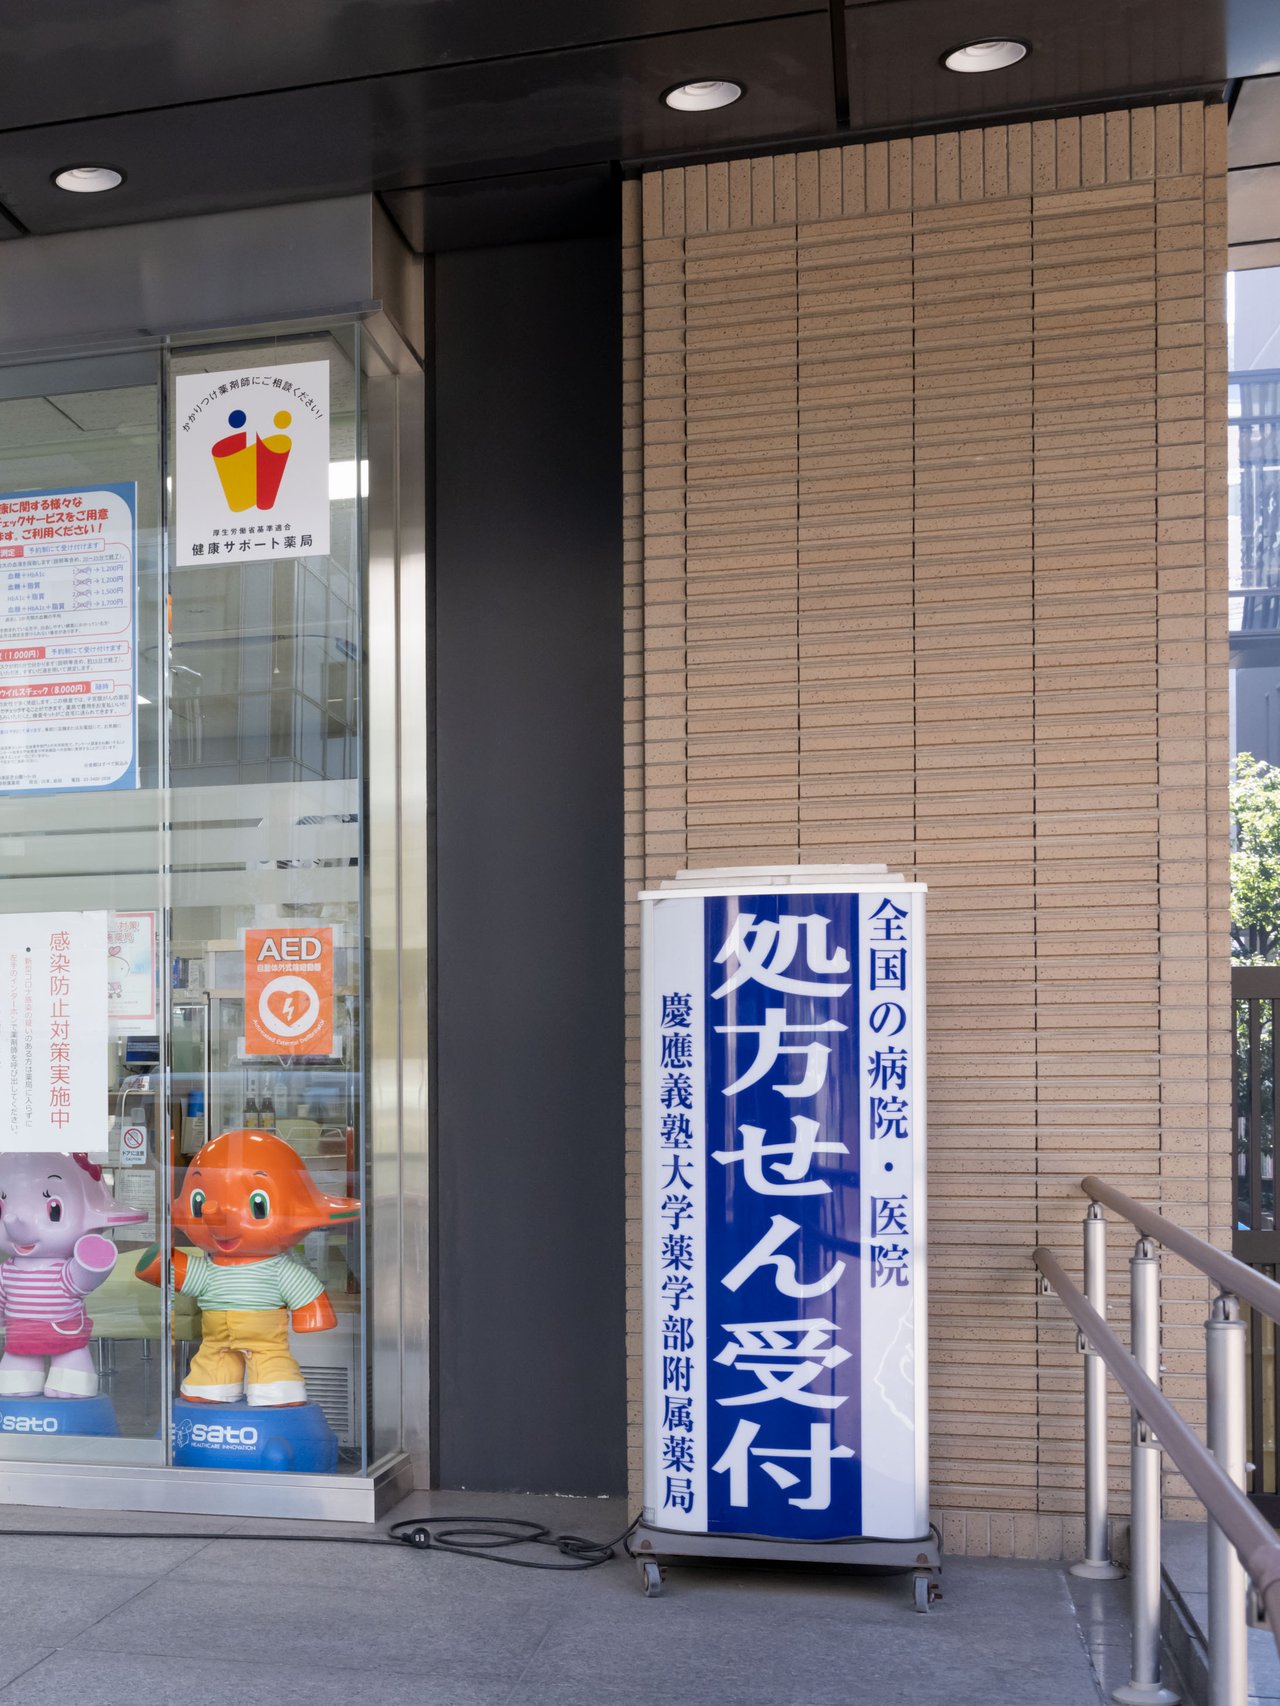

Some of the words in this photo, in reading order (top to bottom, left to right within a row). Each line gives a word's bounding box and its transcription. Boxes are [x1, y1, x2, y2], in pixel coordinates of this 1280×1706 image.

[212, 523, 292, 537] 厚生労働省基準適合
[191, 534, 313, 556] 健康サポート薬局
[256, 936, 322, 962] AED
[49, 930, 71, 1129] 感染防止対策実施中
[867, 897, 910, 1290] 全国の病院・医院
[710, 911, 856, 1511] 処方せん受付
[660, 991, 695, 1515] 慶應義塾大学薬学部附属薬局
[2, 1415, 58, 1433] sato
[191, 1423, 258, 1445] sato
